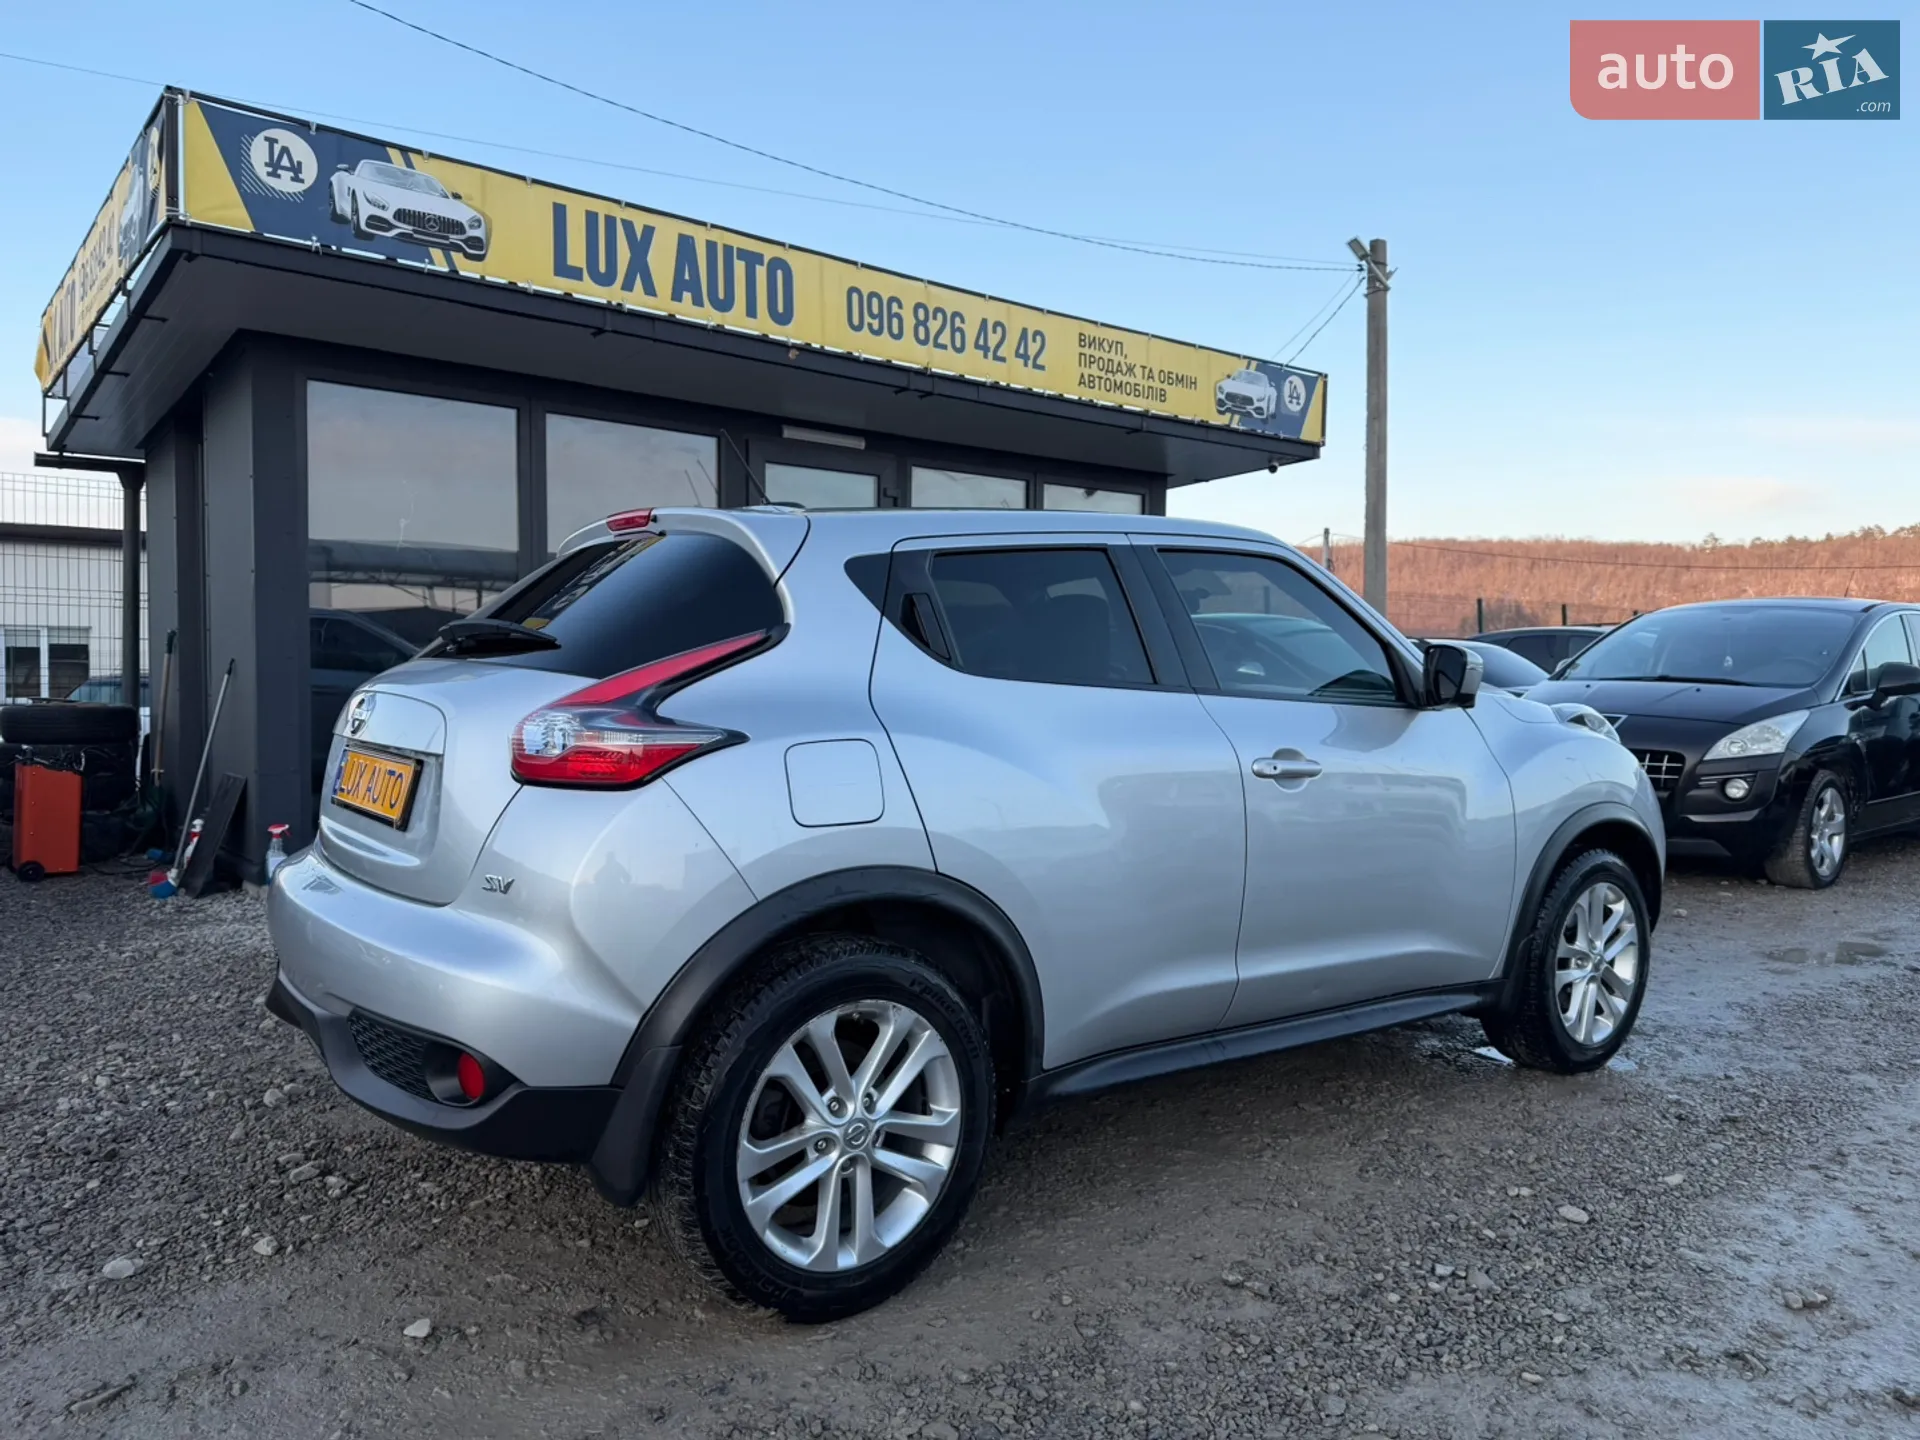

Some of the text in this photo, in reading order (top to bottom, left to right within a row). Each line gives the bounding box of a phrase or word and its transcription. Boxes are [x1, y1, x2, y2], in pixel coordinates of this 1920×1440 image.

[551, 201, 795, 327] LUX AUTO
[846, 286, 1046, 371] 096 826 42 42
[1078, 332, 1128, 359] ВИКУП,
[1077, 372, 1167, 403] АВТОМОБІЛІВ
[1078, 352, 1198, 391] ПРОДАЖ ТА ОБМІН
[363, 764, 404, 810] AUTO
[481, 874, 516, 895] SV
